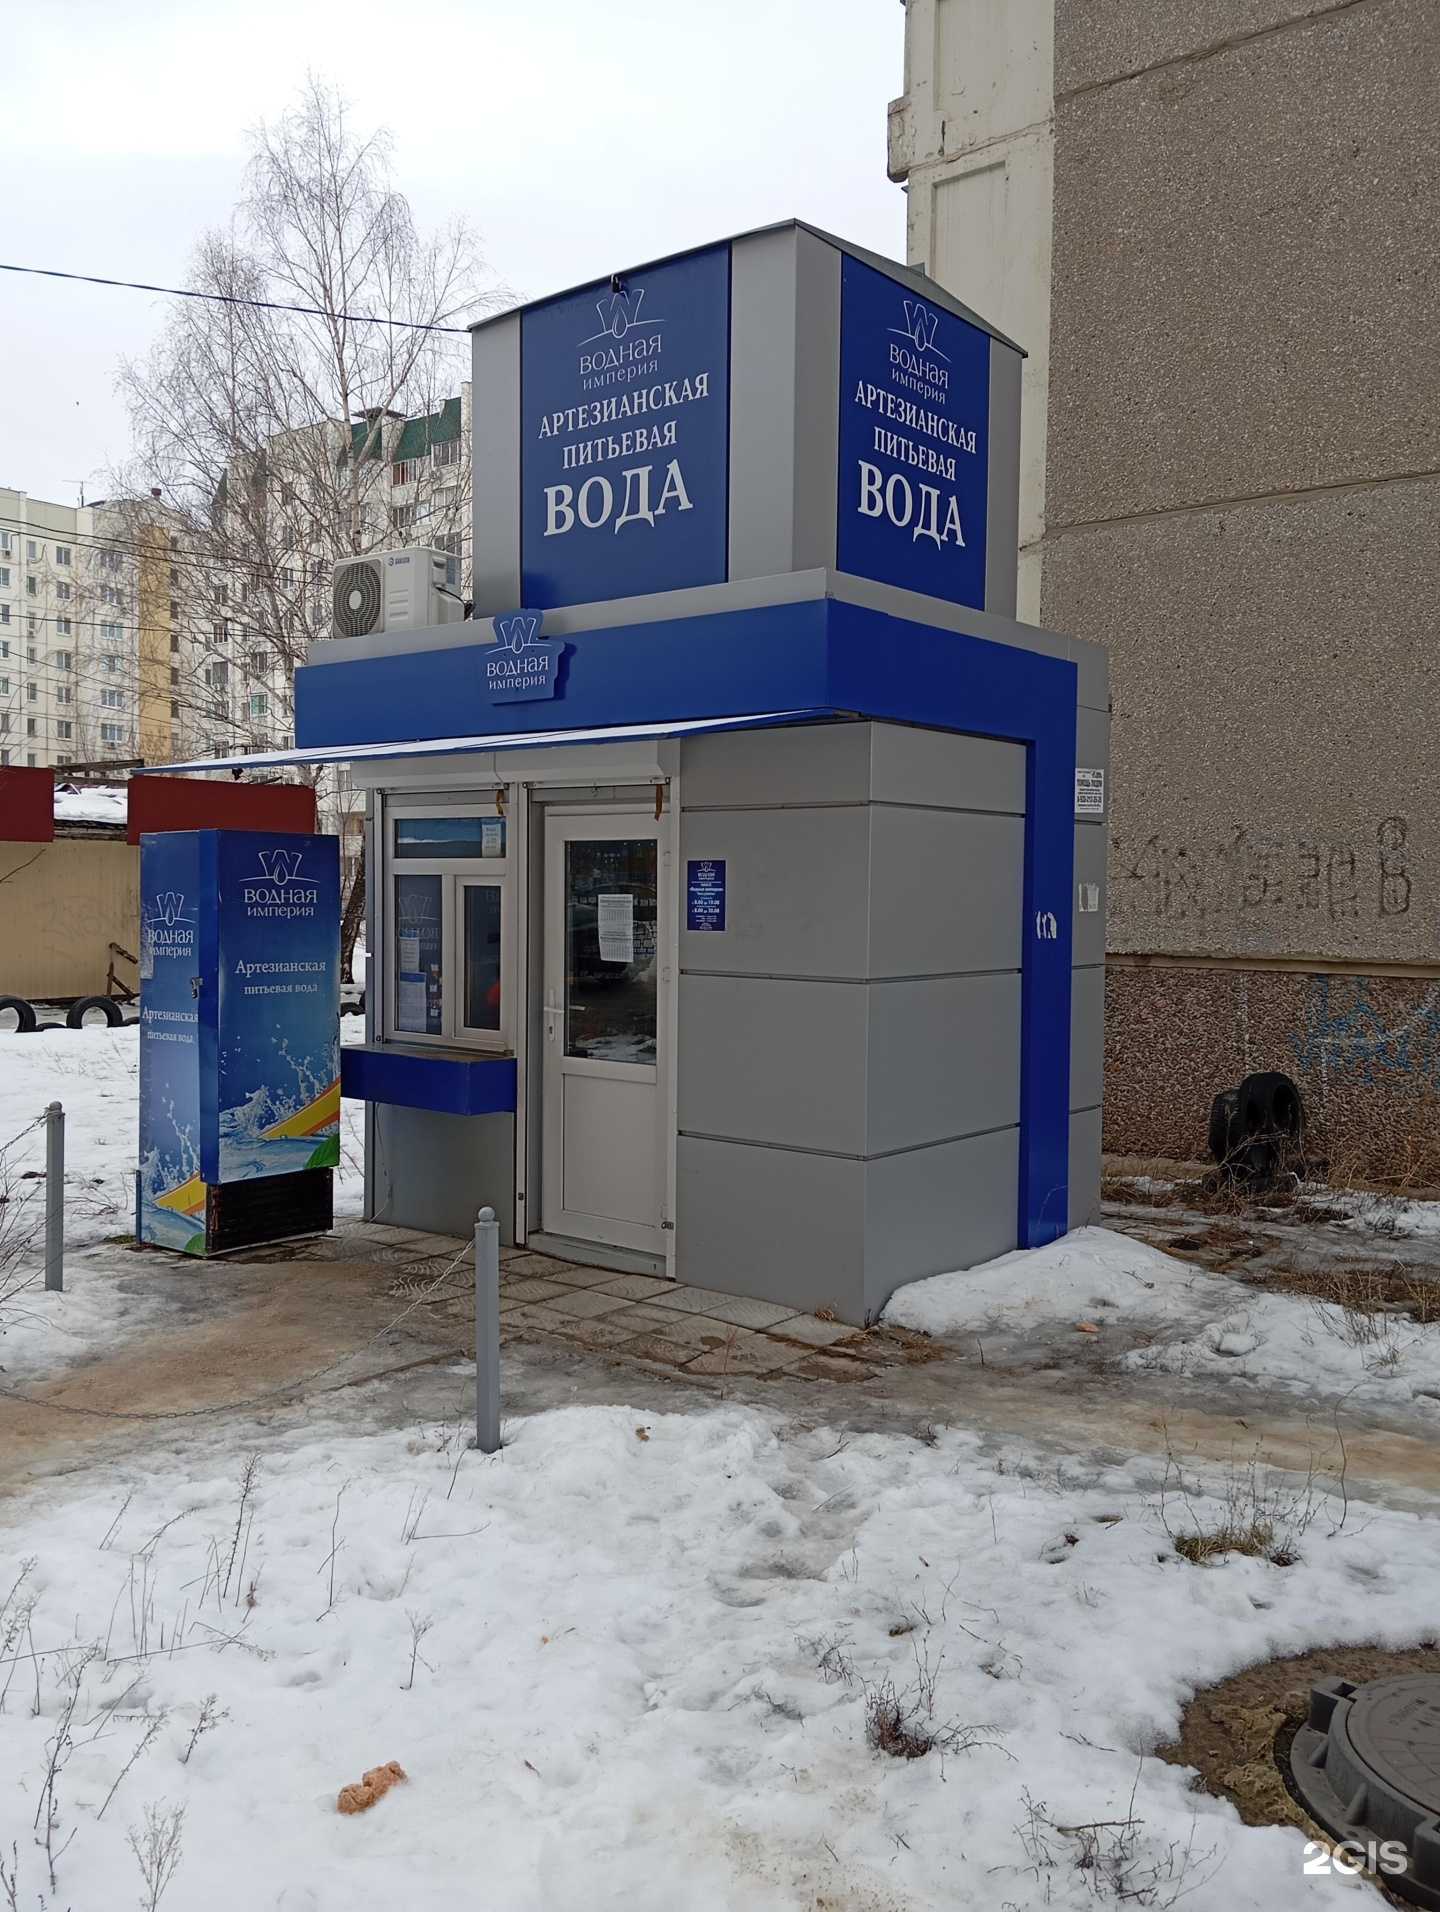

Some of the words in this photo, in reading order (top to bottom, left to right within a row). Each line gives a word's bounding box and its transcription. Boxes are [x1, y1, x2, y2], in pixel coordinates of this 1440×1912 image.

[583, 359, 658, 391] империя
[892, 367, 946, 404] империя
[538, 372, 709, 439] АРТЕЗИАНСКАЯ
[855, 380, 977, 454] АРТЕЗИАНСКАЯ
[562, 420, 677, 469] ПИТЬЕВАЯ
[873, 426, 957, 481] ПИТЬЕВАЯ
[543, 458, 693, 536] ВОДА
[857, 459, 965, 551] ВОДА
[489, 673, 546, 690] империя
[247, 905, 314, 919] империя
[234, 959, 326, 978] Артезианская
